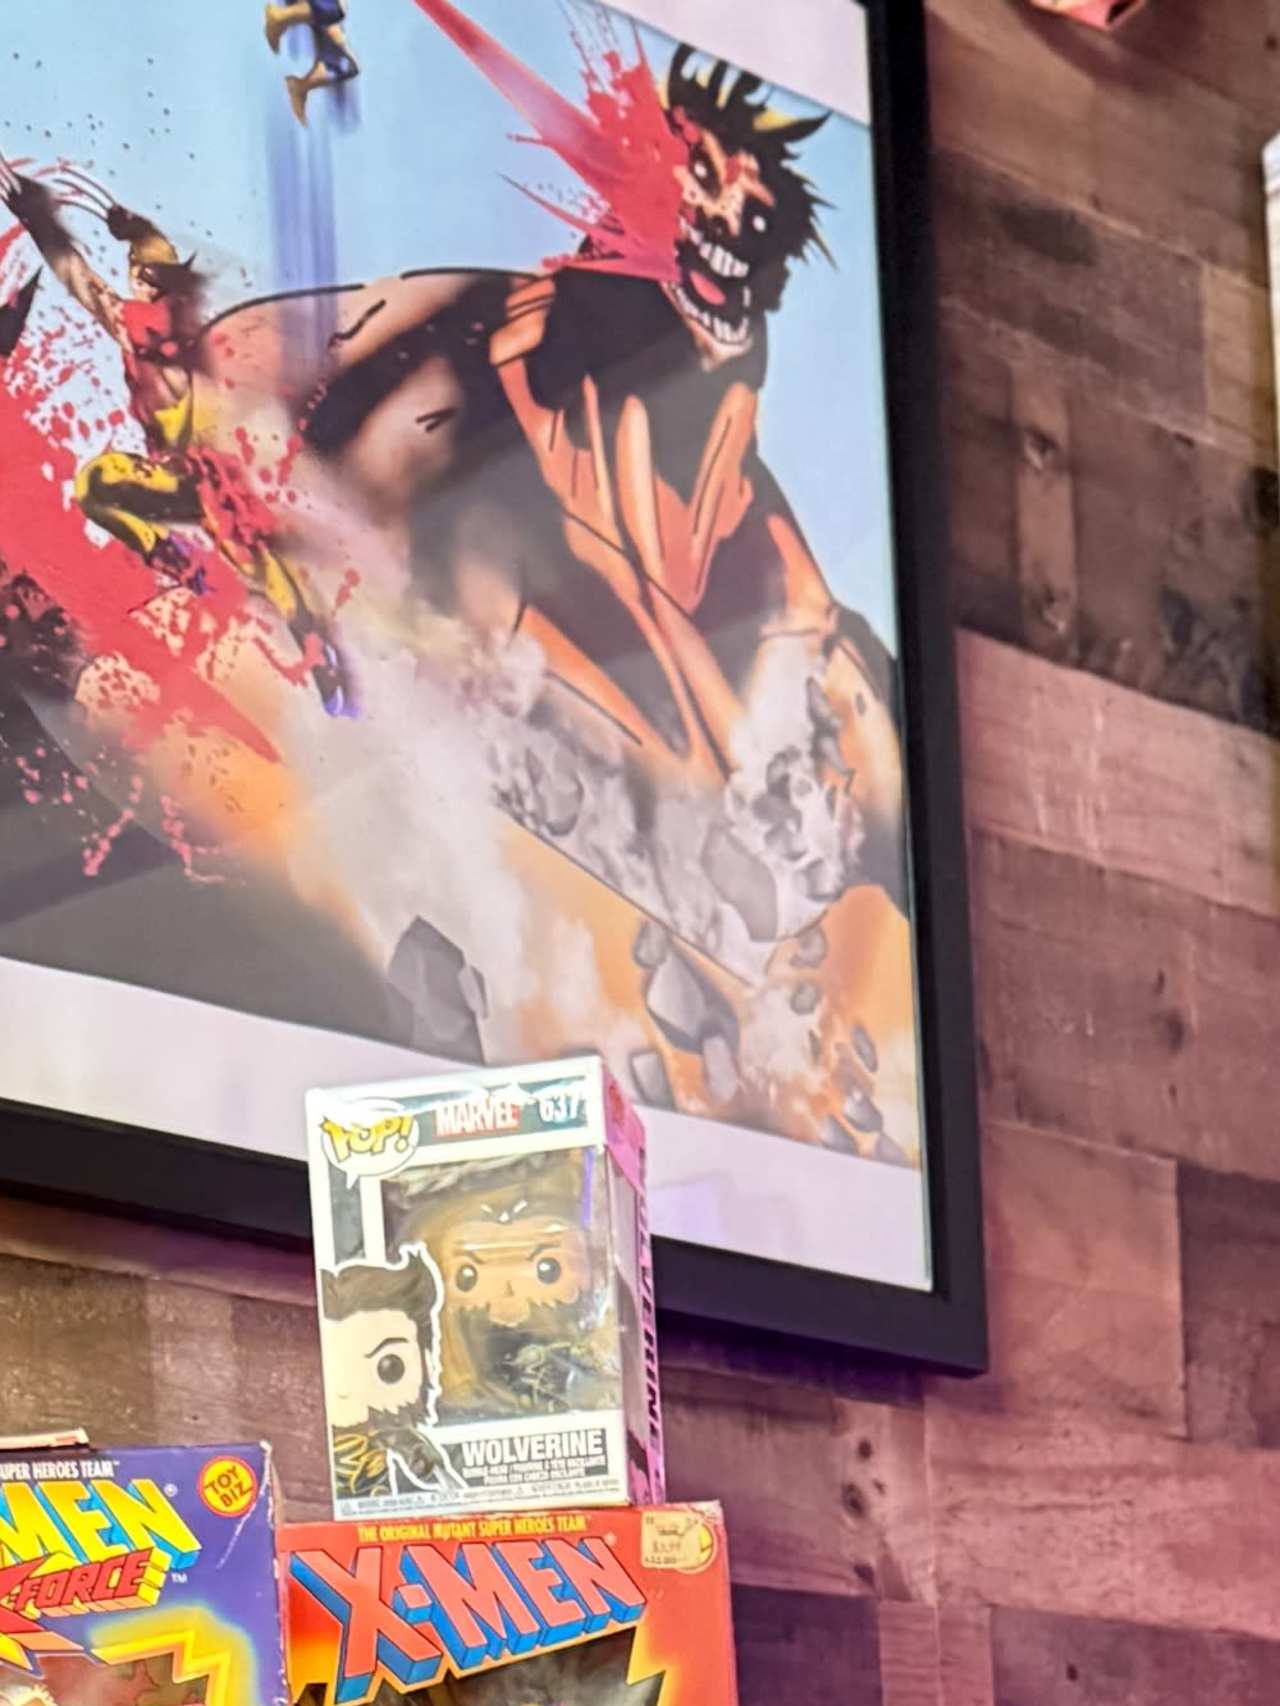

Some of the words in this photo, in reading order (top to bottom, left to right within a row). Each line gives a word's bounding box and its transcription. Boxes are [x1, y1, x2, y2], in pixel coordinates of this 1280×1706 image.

[436, 1099, 520, 1136] MARVEL
[460, 1429, 604, 1467] WOLVERINE
[32, 1461, 78, 1479] HEROES
[81, 1460, 114, 1478] TEAM
[204, 1465, 239, 1495] TOY
[220, 1480, 252, 1508] BIZ
[357, 1526, 378, 1542] THE
[380, 1524, 430, 1540] ORIGINAL
[433, 1521, 477, 1539] MUTANT
[479, 1519, 511, 1537] SUPER
[514, 1517, 554, 1535] HEROES
[557, 1515, 586, 1532] TEAM
[289, 1537, 647, 1705] X-MEN
